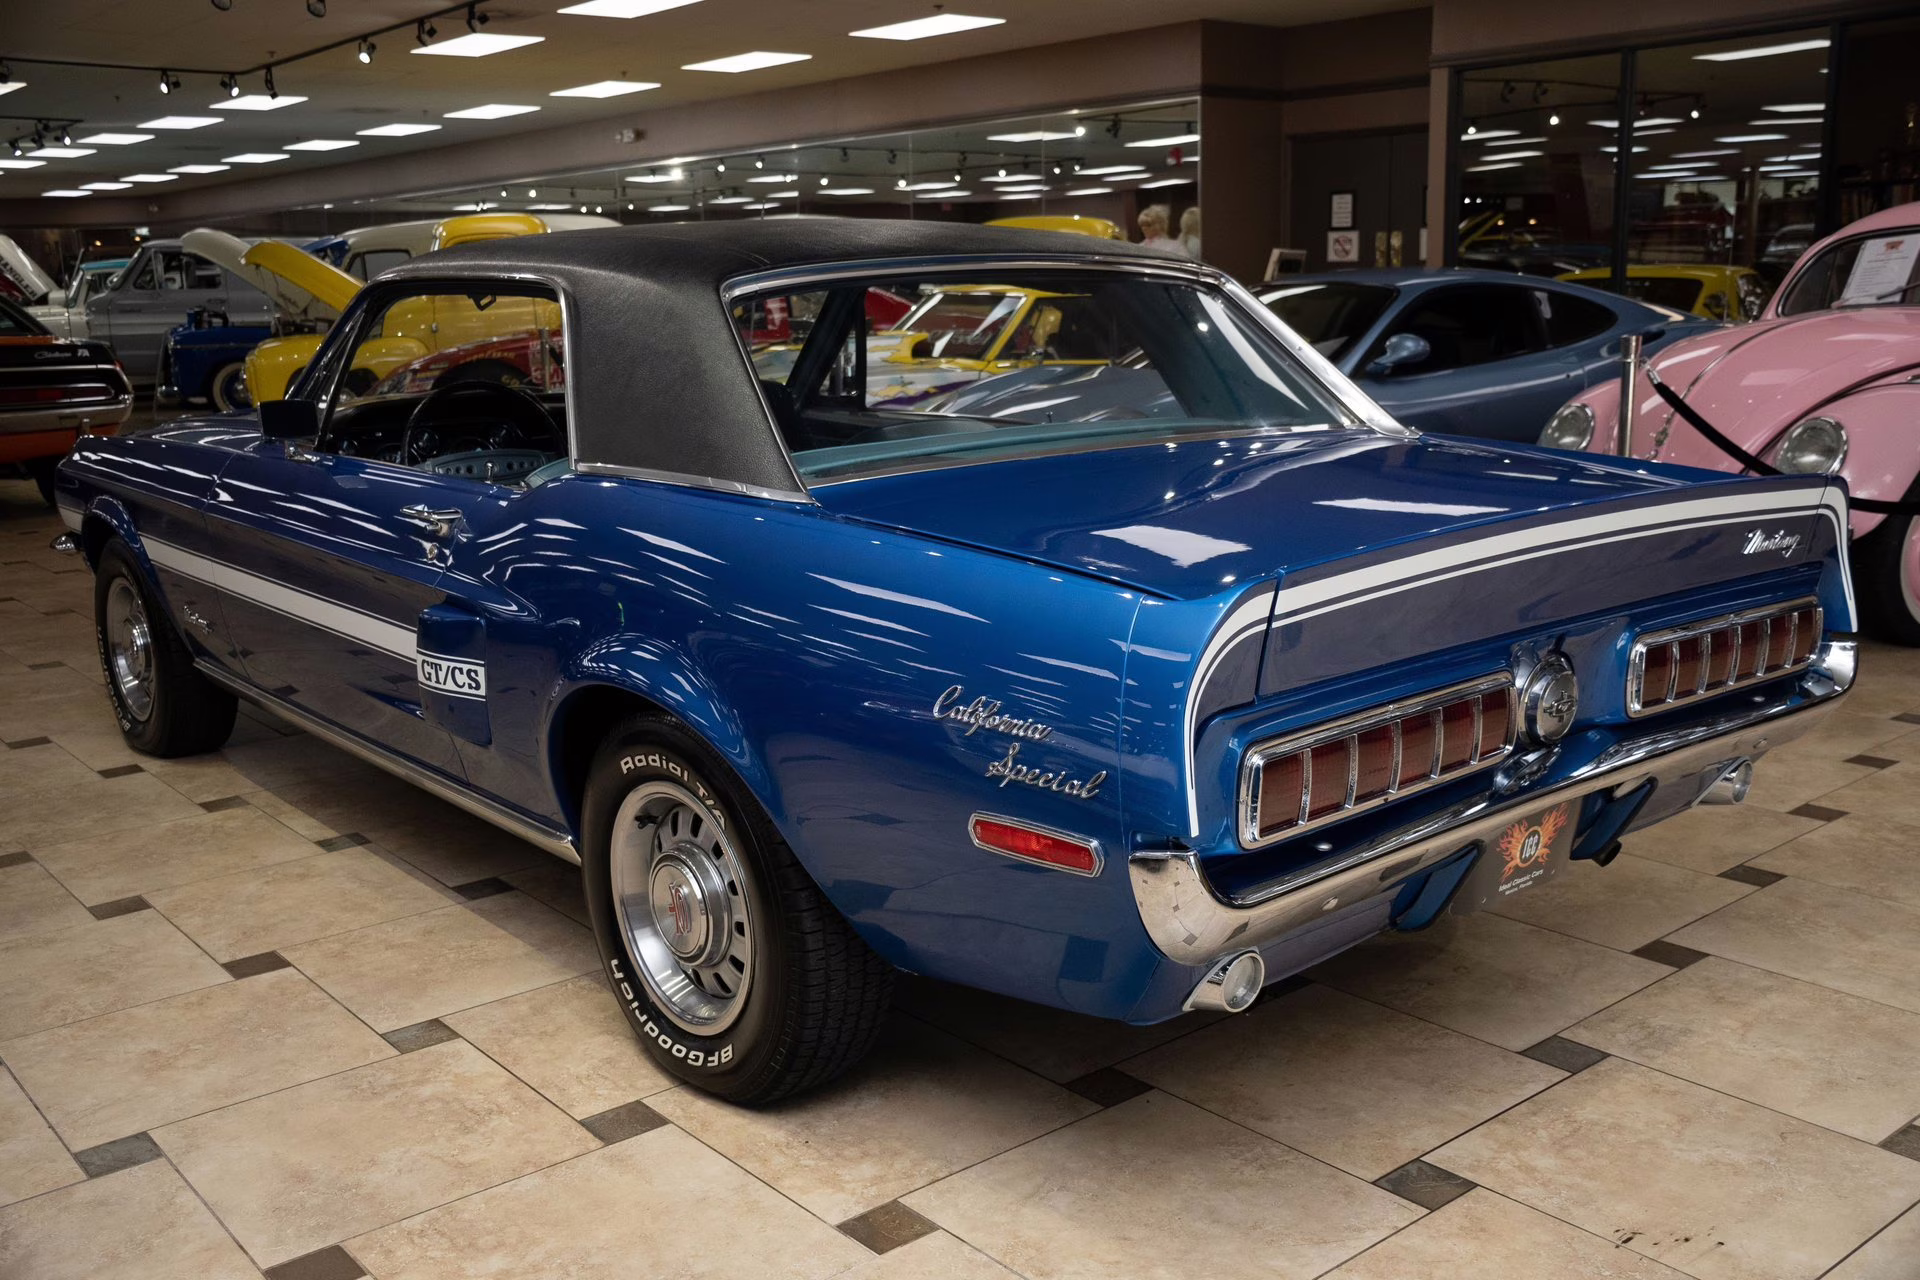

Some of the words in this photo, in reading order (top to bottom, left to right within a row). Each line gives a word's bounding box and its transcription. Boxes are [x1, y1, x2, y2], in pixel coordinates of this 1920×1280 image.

[1741, 528, 1801, 558] Mustang
[421, 659, 481, 691] GT/CS
[932, 684, 1054, 740] California
[620, 753, 689, 781] Radial
[984, 741, 1107, 799] Special
[1521, 834, 1539, 859] ICC
[1498, 881, 1514, 892] Ideal
[1512, 875, 1531, 886] Classic
[1531, 869, 1544, 878] Cars
[610, 959, 734, 1067] BFGoodrich
